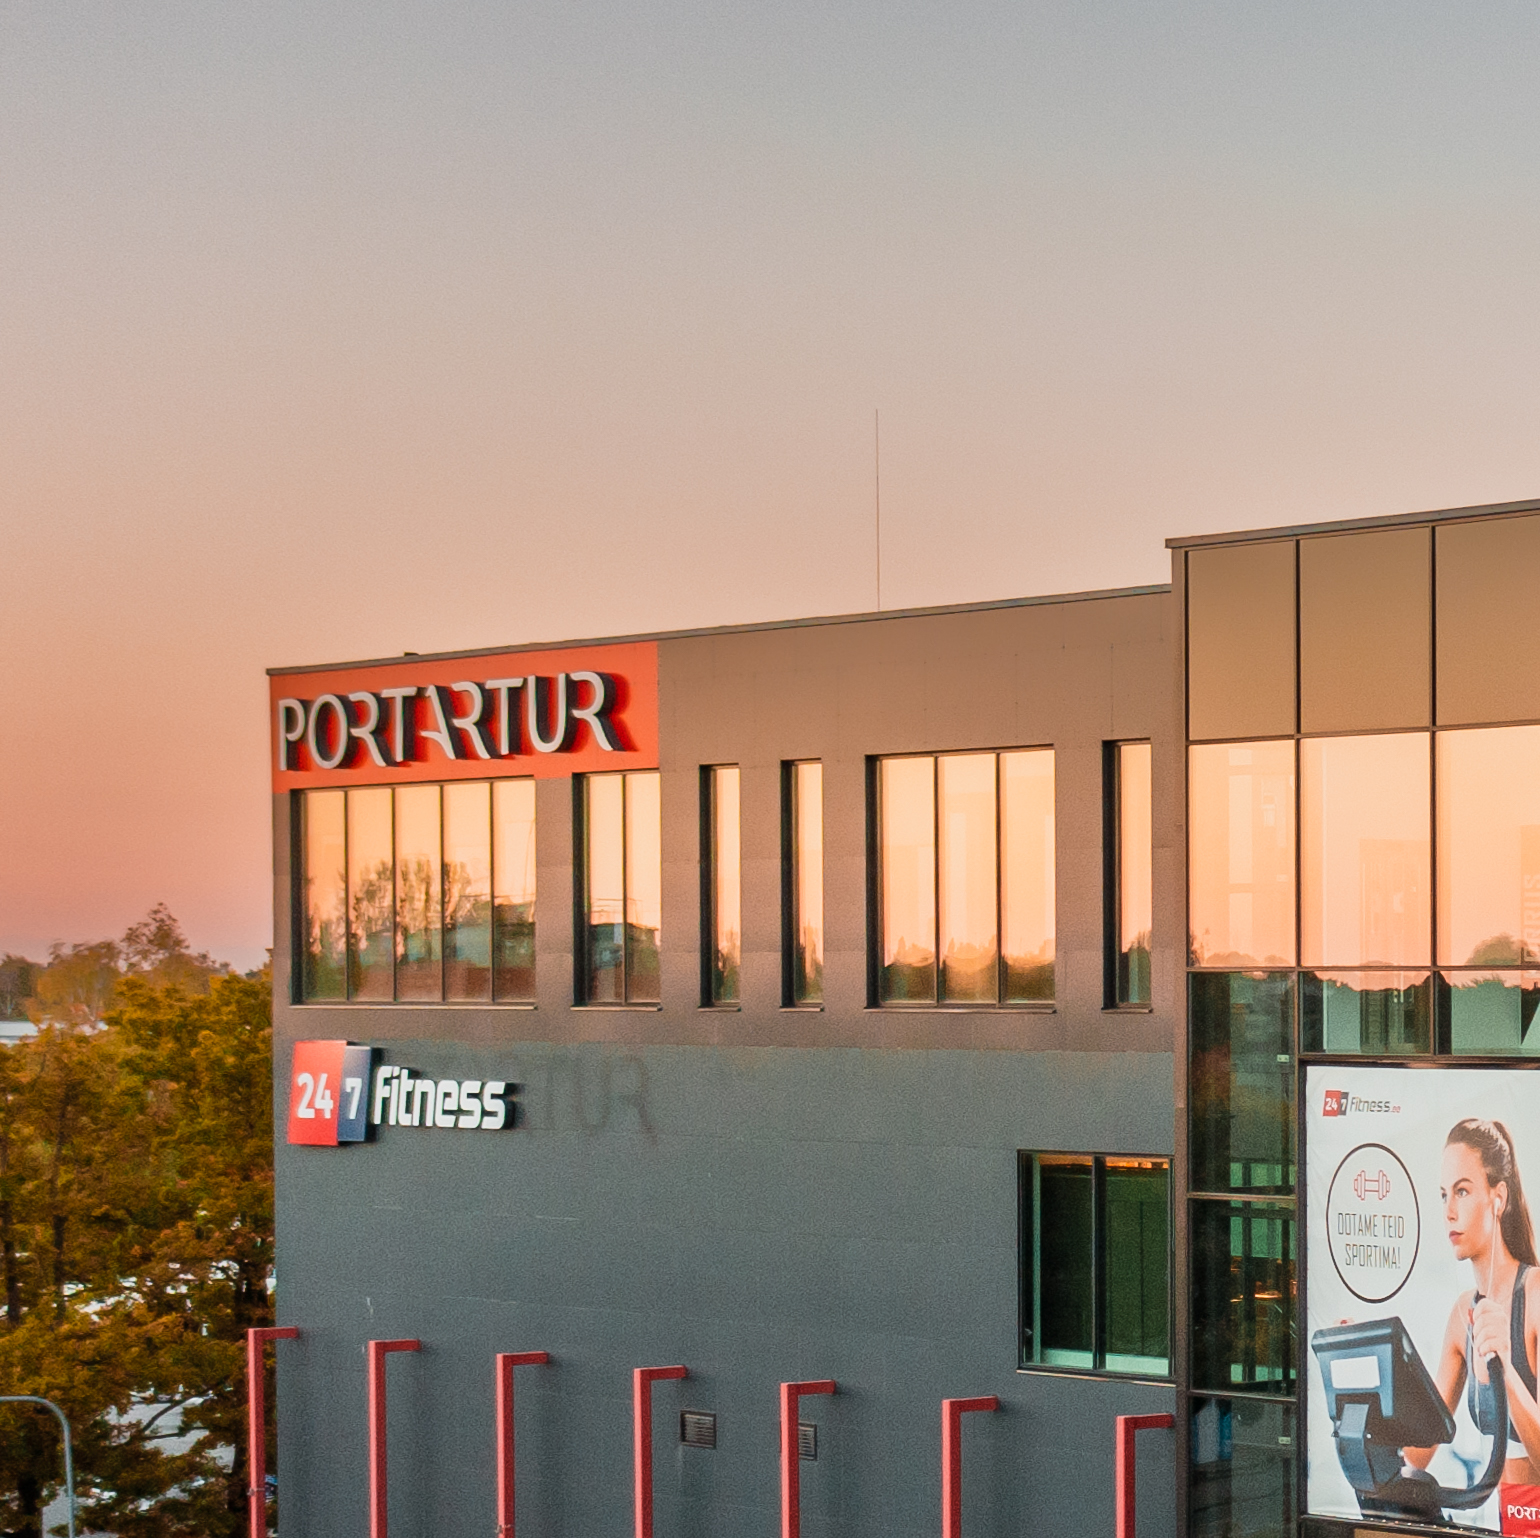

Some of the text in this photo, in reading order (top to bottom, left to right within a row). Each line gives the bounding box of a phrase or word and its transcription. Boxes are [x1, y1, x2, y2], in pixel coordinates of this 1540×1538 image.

[296, 1072, 334, 1120] 24
[344, 1077, 362, 1120] 7
[1324, 1097, 1338, 1111] 24
[1337, 1213, 1405, 1239] OOTAME TEID
[1345, 1244, 1401, 1270] SPORTIMA!
